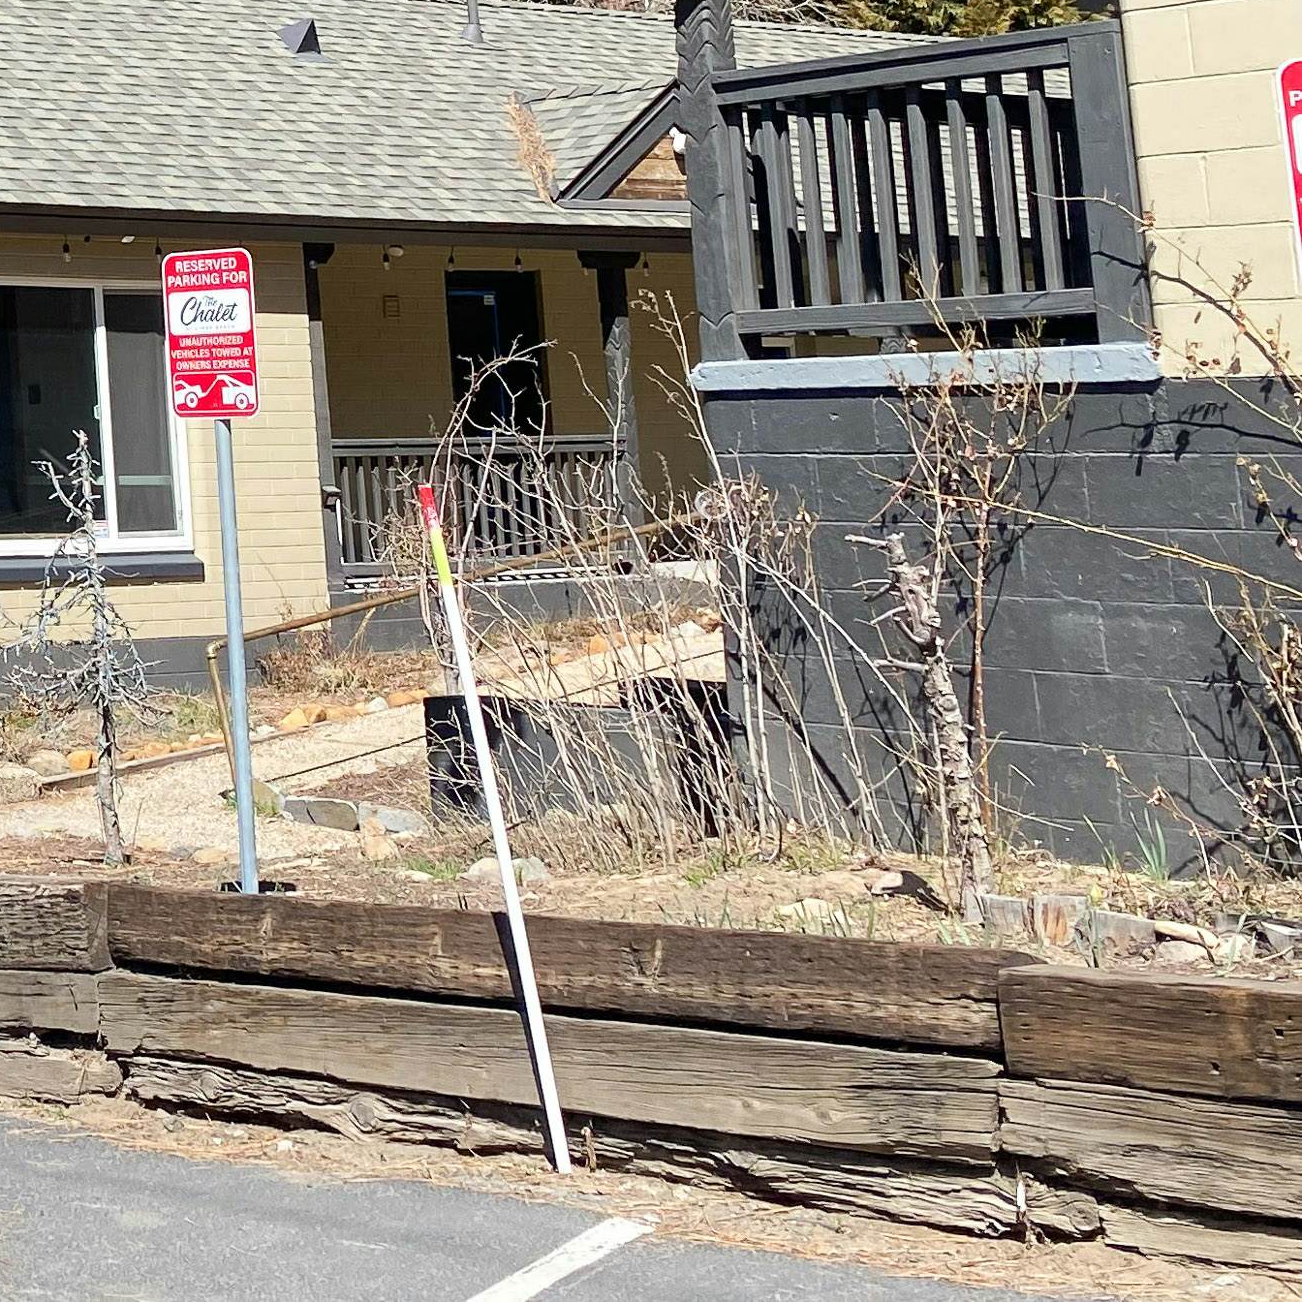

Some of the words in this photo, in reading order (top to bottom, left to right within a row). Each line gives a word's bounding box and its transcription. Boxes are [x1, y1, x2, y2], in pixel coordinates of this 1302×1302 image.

[175, 257, 237, 273] RESERVED
[168, 273, 220, 288] PARKING
[222, 271, 248, 284] FOR
[180, 296, 238, 326] Chalet
[179, 335, 244, 347] UNAUTHORIZED
[171, 348, 210, 359] VEHICLES
[211, 347, 242, 358] TOWED
[243, 346, 253, 356] AT
[176, 360, 211, 371] OWNERS
[213, 358, 251, 370] EXPENSE
